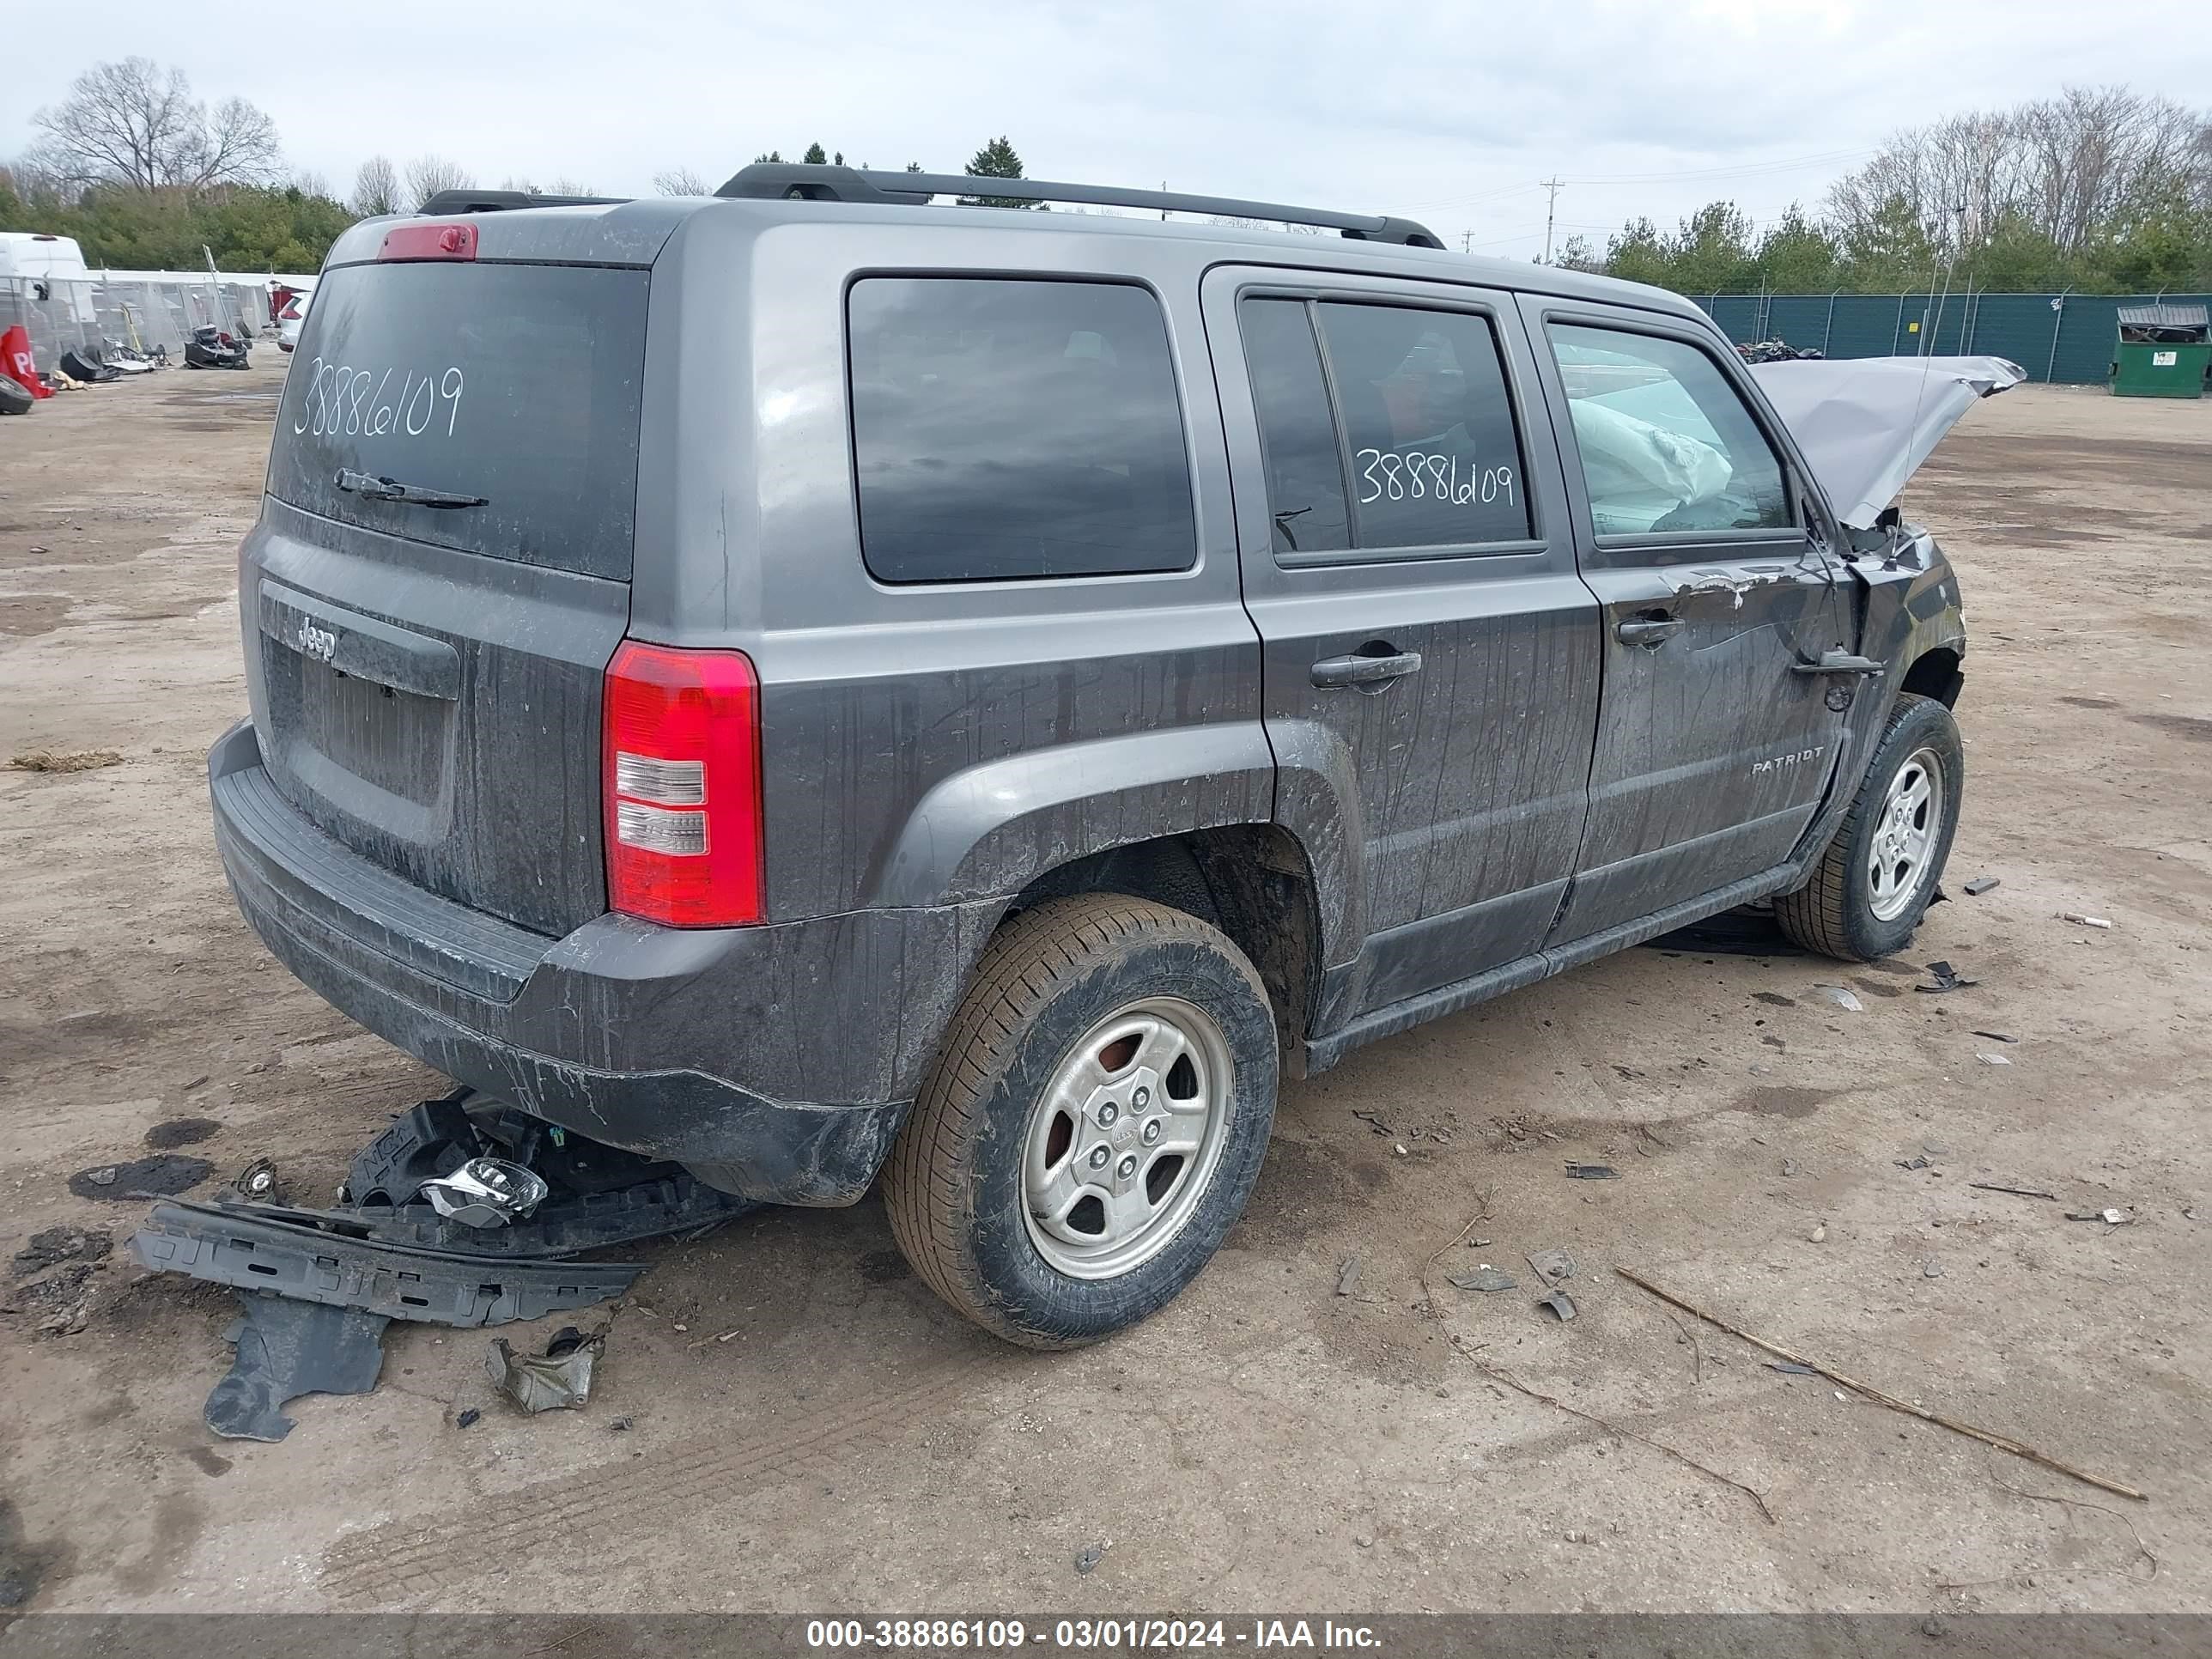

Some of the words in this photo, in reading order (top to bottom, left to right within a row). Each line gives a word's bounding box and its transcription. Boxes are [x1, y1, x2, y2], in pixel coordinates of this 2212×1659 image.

[295, 357, 464, 437] 38886109
[1356, 448, 1514, 507] 38886109
[298, 617, 336, 663] Jeep
[1752, 746, 1825, 775] PATRIOT
